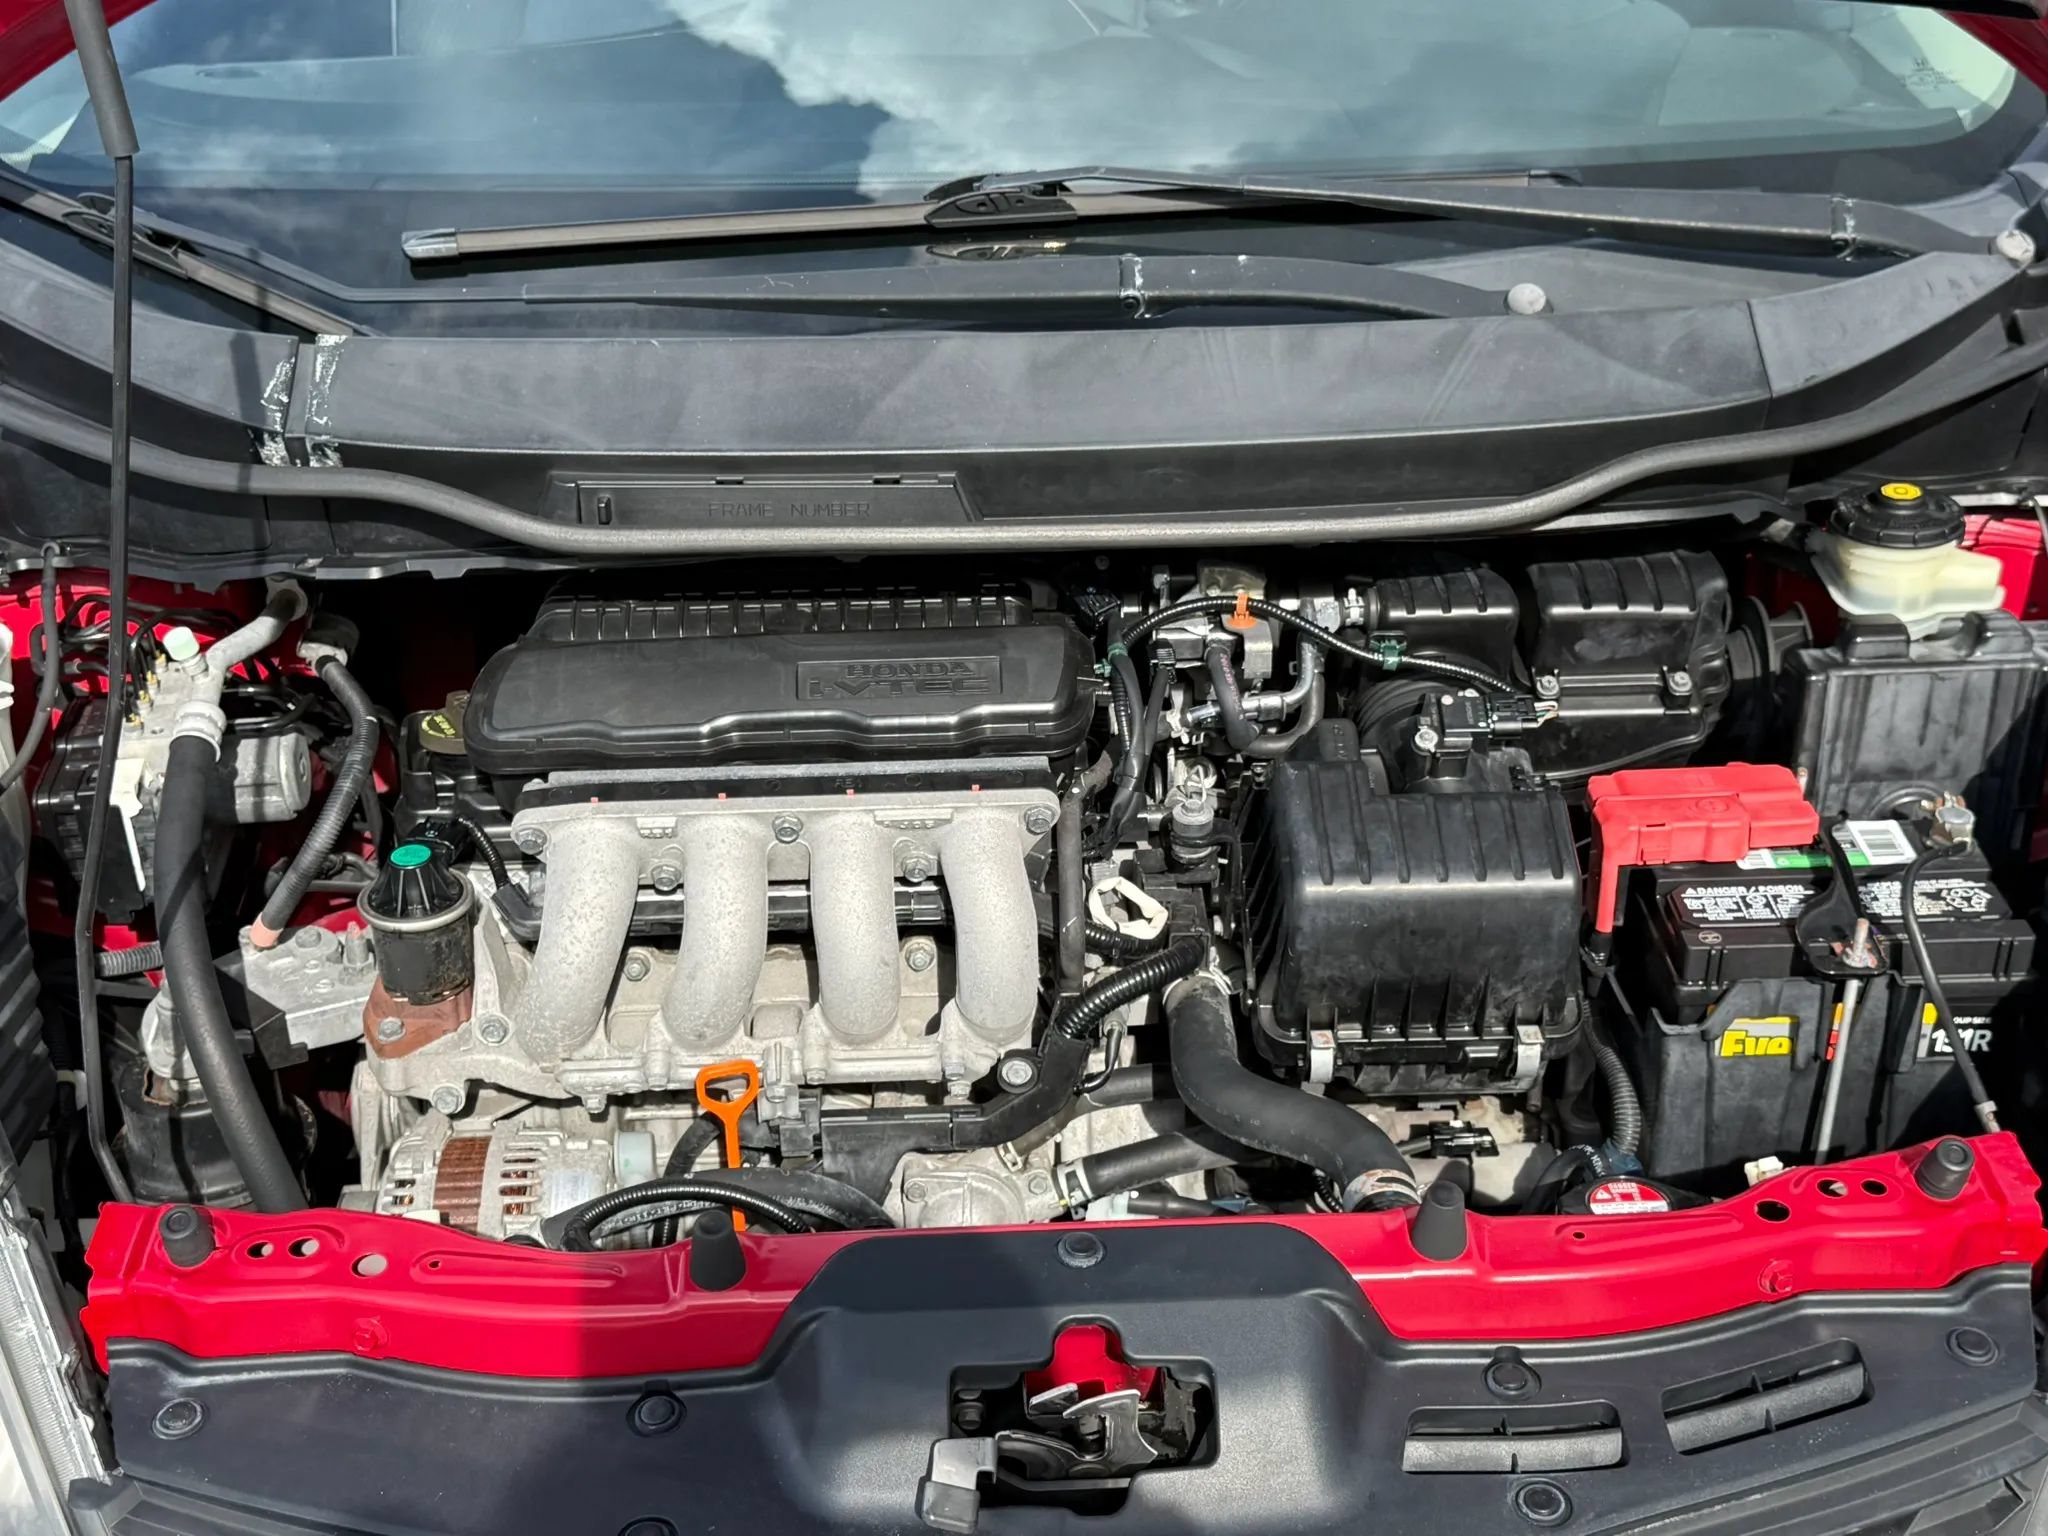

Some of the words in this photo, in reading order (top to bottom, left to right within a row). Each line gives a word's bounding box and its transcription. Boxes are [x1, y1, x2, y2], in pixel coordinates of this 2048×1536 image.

[708, 503, 774, 517] FRAME
[790, 502, 871, 517] NUMBER
[847, 661, 976, 678] HONDA
